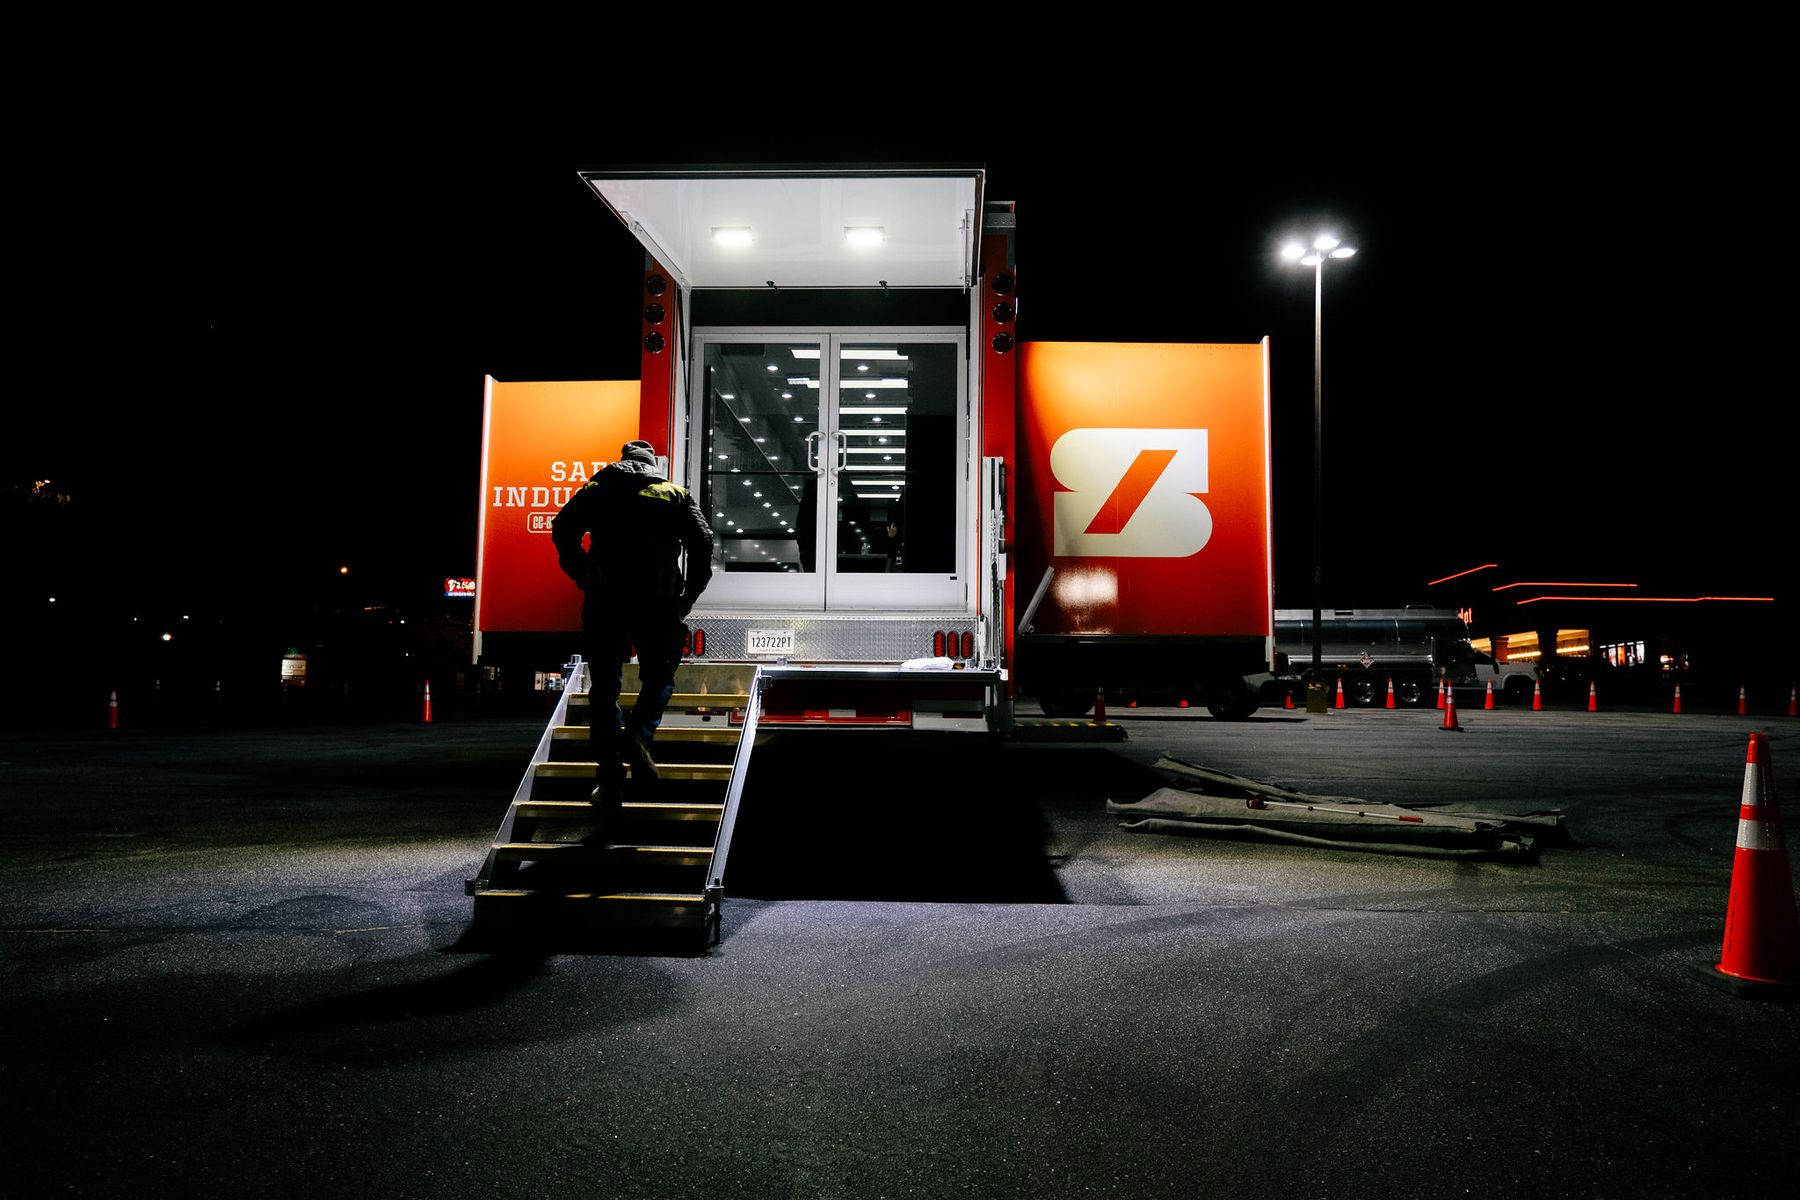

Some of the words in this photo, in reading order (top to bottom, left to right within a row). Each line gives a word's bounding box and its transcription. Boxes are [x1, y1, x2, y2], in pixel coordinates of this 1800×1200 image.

[493, 486, 583, 507] INDU
[533, 515, 556, 529] CC-8
[751, 636, 792, 648] 123722PT
